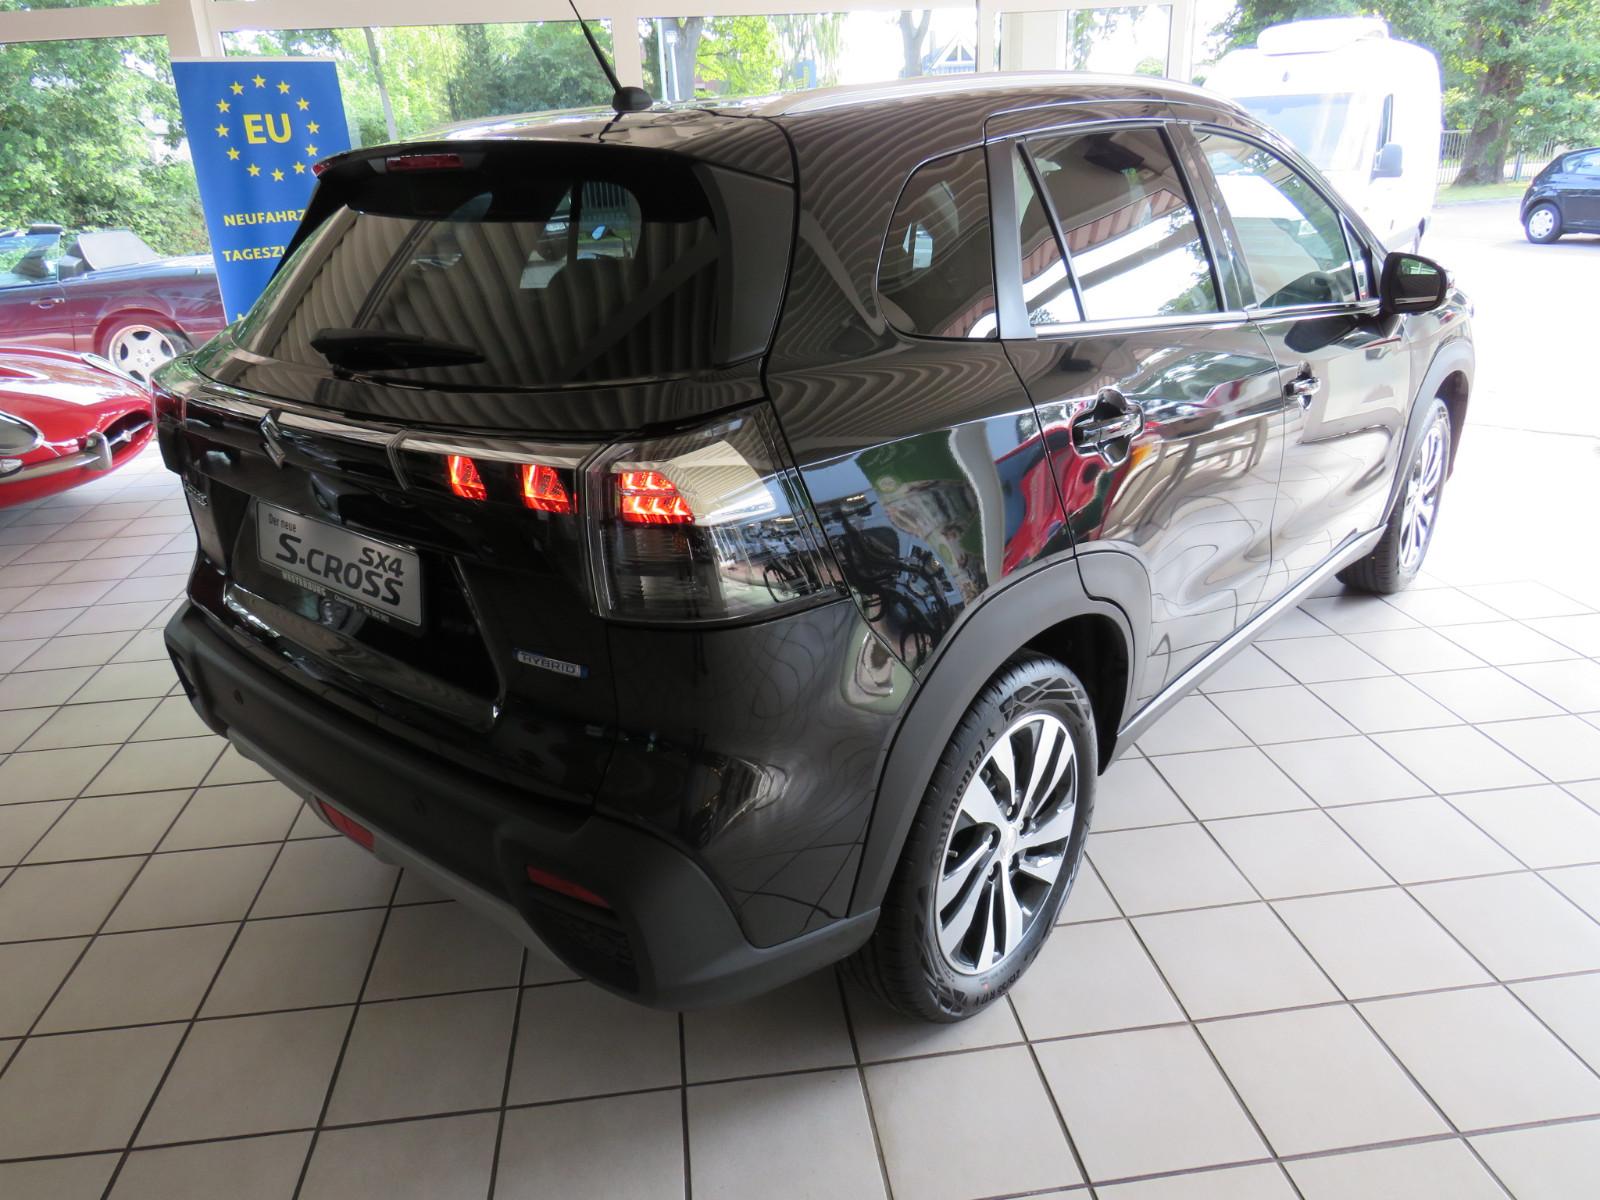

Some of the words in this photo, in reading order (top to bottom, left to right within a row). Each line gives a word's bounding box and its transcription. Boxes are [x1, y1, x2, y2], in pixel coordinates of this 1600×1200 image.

[243, 113, 292, 144] EU
[268, 513, 279, 527] Der
[280, 519, 297, 533] neue
[358, 547, 405, 578] SX4
[520, 655, 576, 674] HYBRID
[930, 738, 987, 867] Continental
